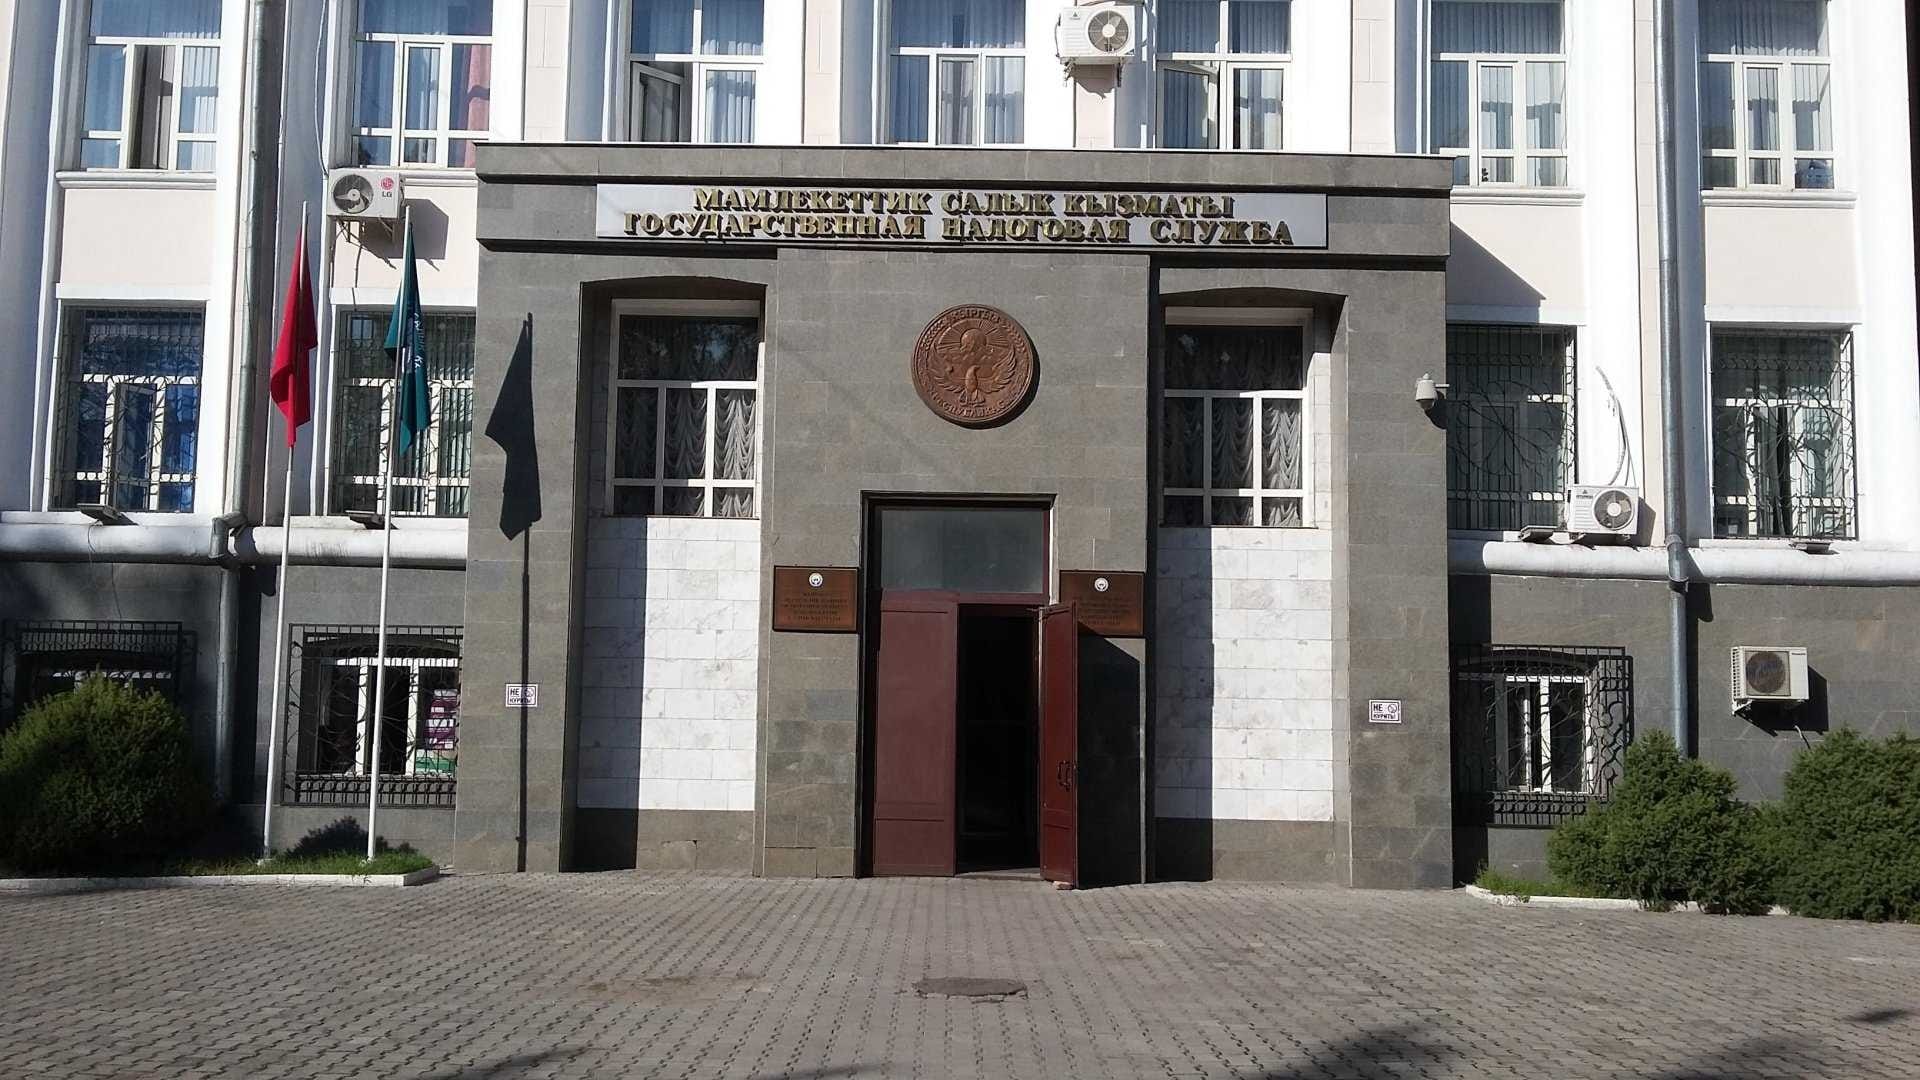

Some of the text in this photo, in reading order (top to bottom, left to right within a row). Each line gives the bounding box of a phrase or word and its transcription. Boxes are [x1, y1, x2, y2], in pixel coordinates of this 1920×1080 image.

[693, 187, 1236, 219] МАМЛЕКЕТТИК САЛЫК КЫЗМАТЫ
[623, 212, 1295, 245] ГОСУДАРСТВЕННАЯ НАЛОГОВАЯ СЛУЖБА
[510, 688, 520, 696] НЕ
[1373, 703, 1383, 711] НЕ
